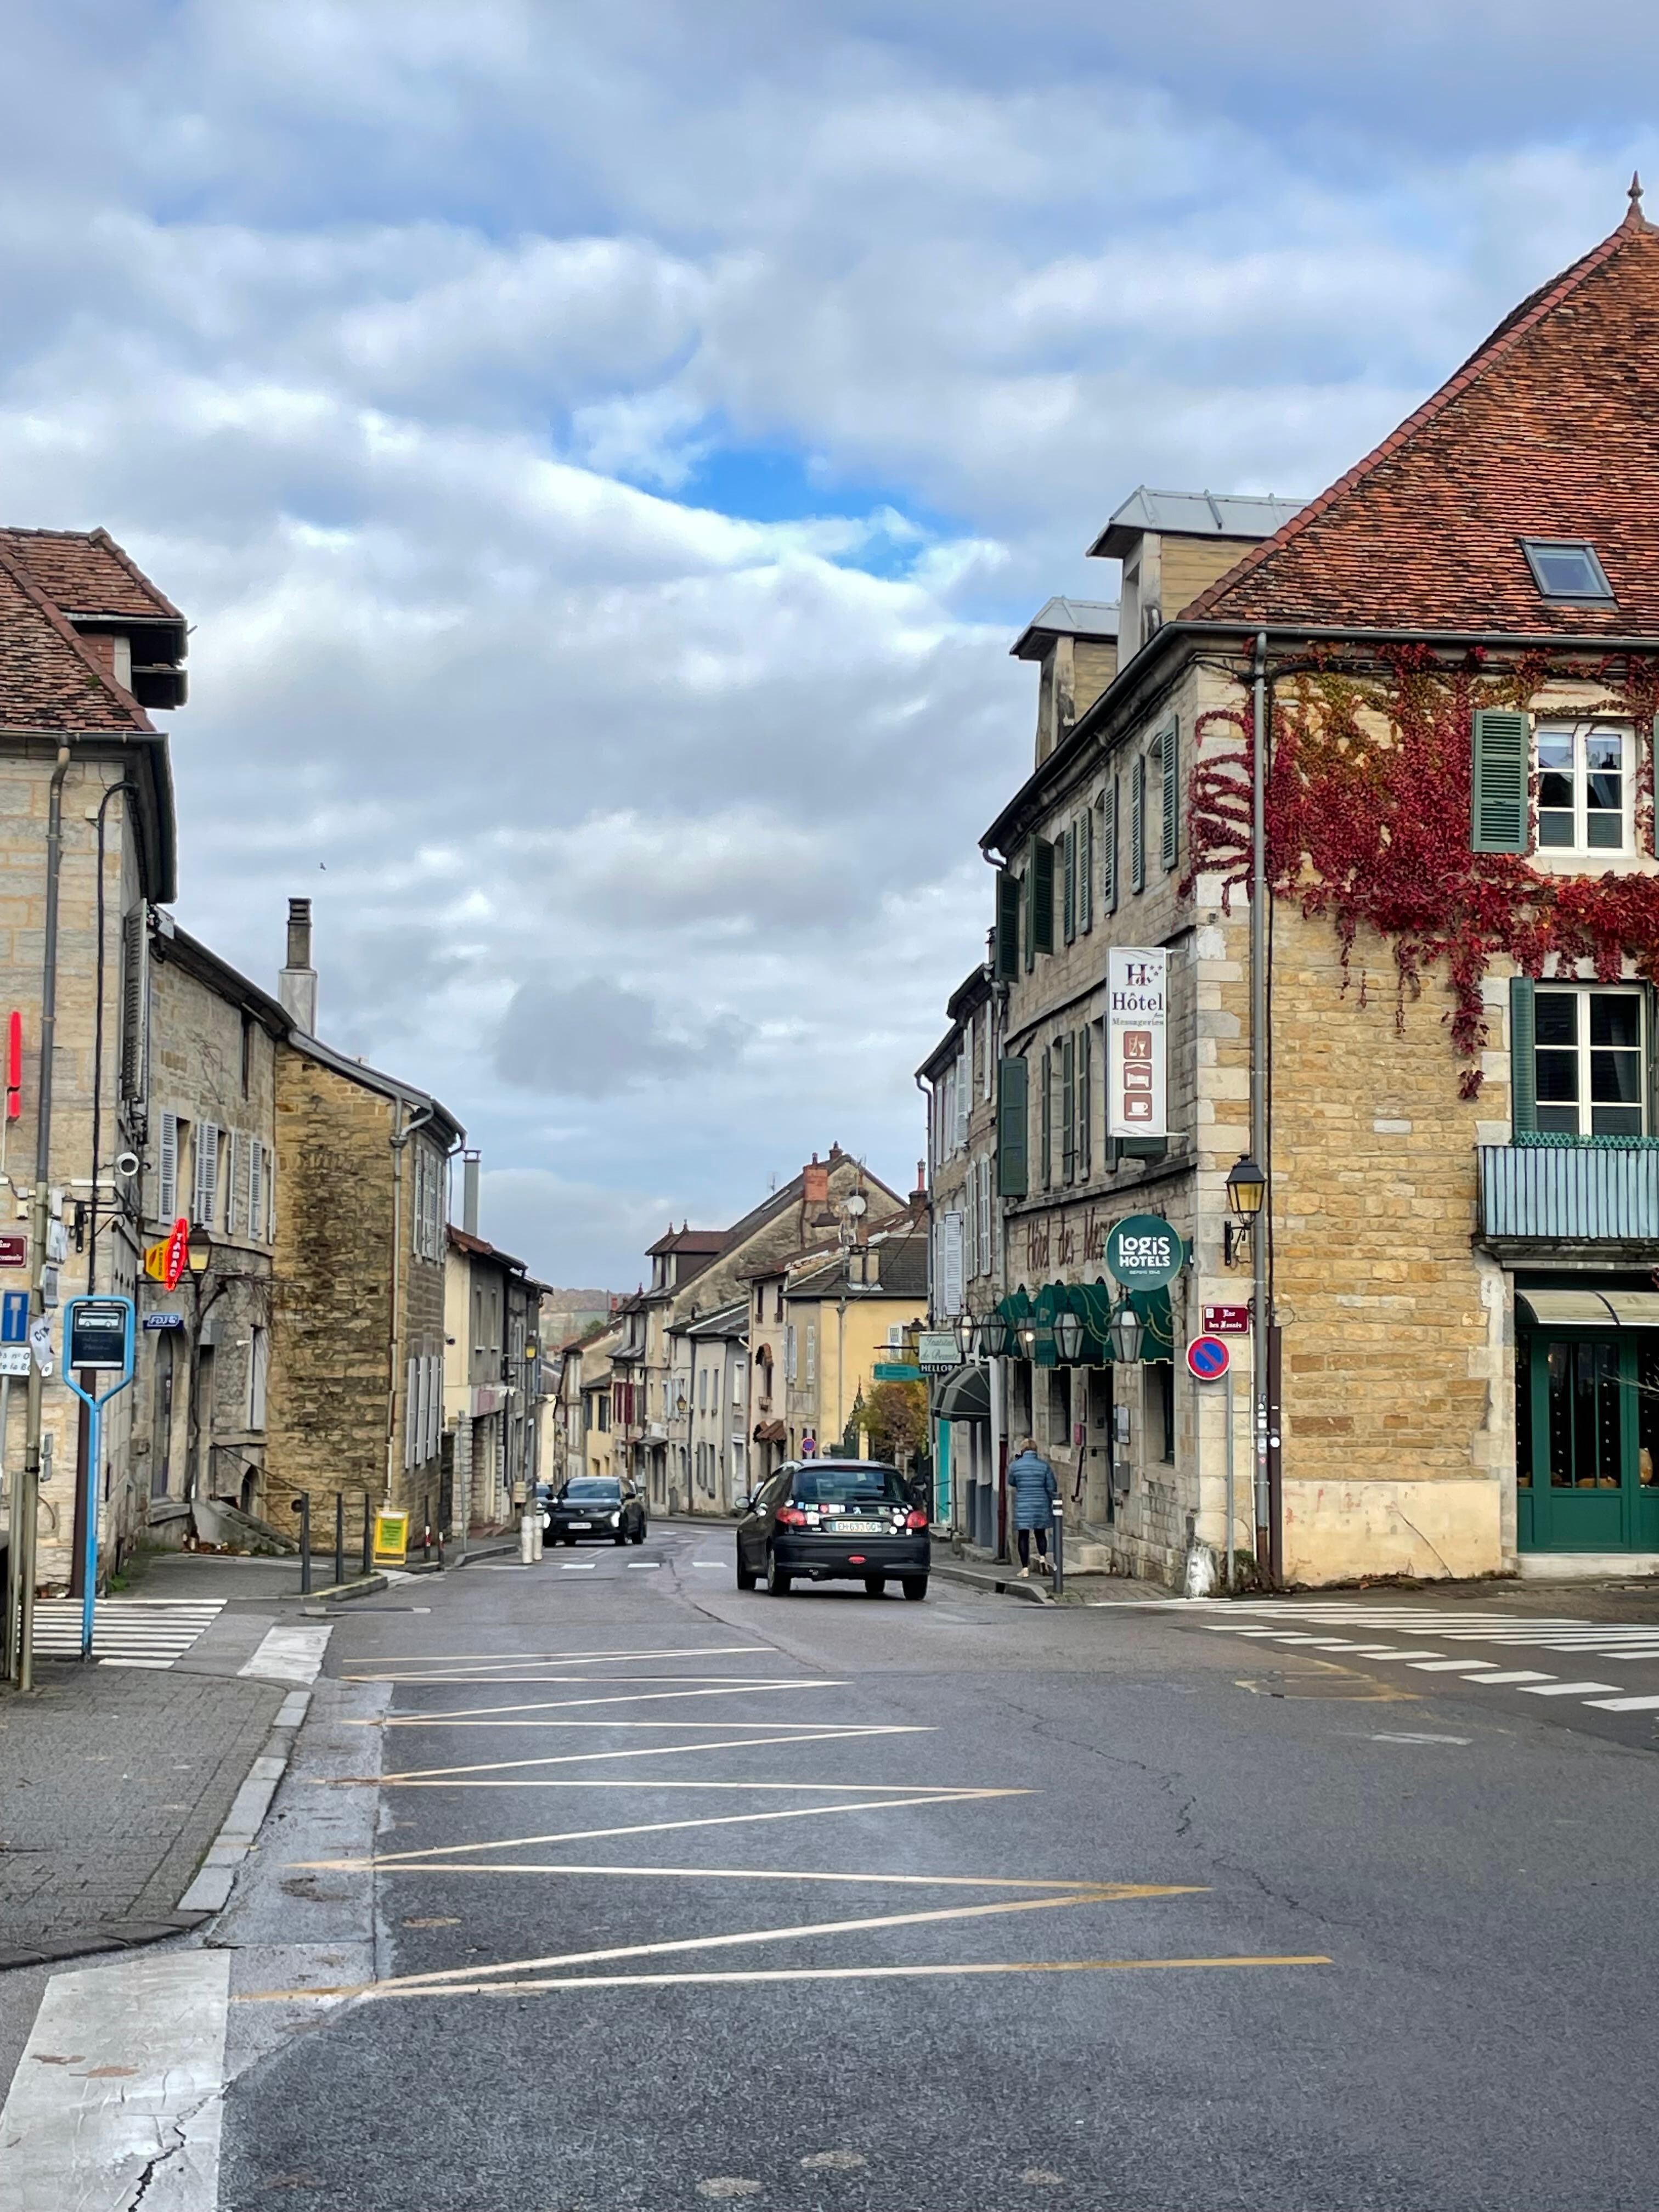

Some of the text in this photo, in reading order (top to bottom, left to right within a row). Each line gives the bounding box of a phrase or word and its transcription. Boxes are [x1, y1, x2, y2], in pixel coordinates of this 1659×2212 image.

[1112, 992, 1164, 1011] Hôtel
[170, 1233, 183, 1277] TABAC
[1119, 1256, 1171, 1268] HOTELS
